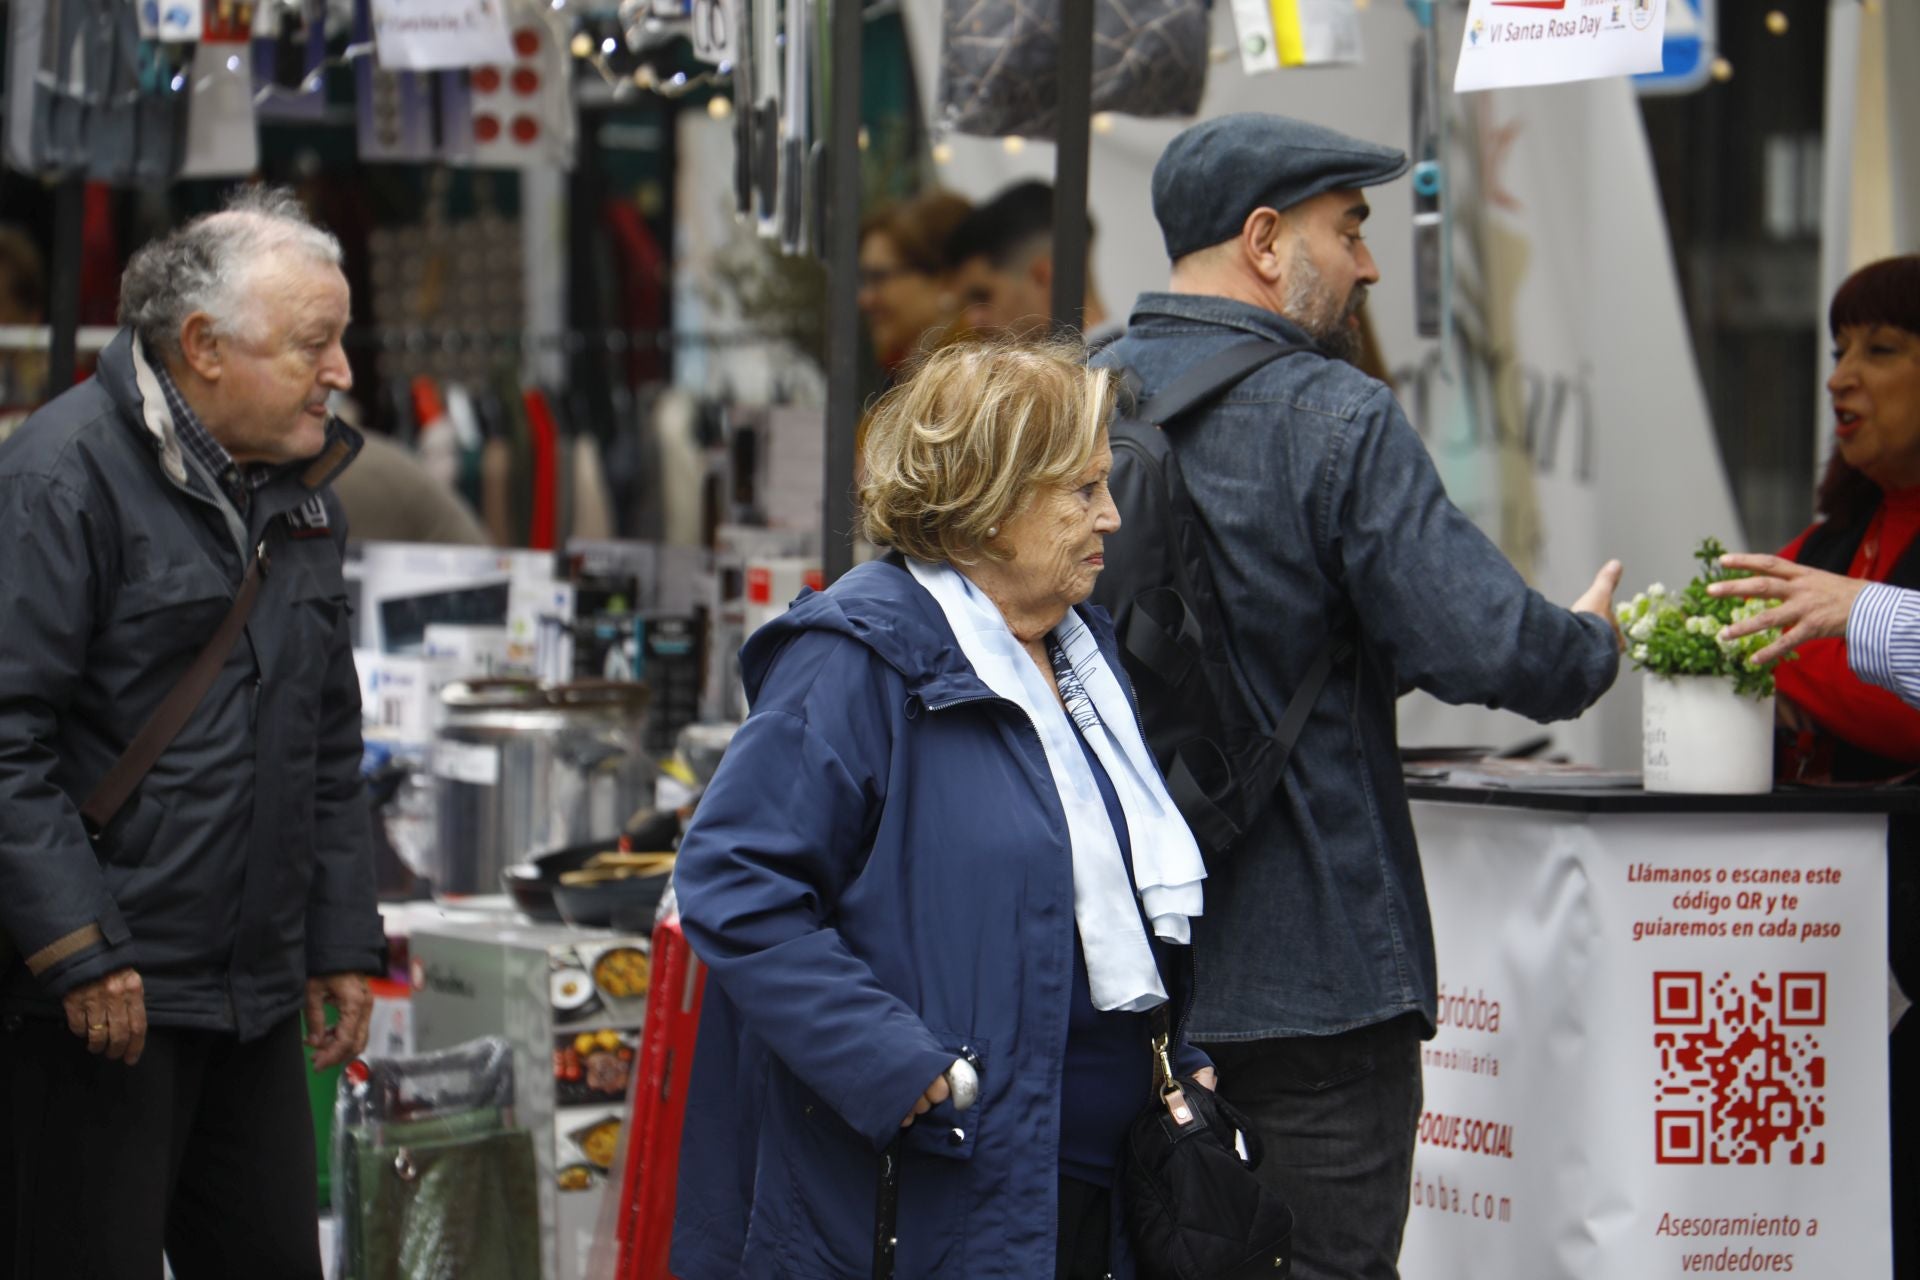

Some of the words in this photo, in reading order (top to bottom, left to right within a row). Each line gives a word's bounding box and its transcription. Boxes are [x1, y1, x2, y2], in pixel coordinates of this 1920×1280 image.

[1505, 23, 1543, 42] Santa
[1547, 18, 1576, 38] Rosa
[1579, 15, 1601, 38] Day
[1628, 863, 1711, 883] Llámanos
[1716, 869, 1727, 883] o
[1732, 869, 1801, 884] escanea
[1806, 867, 1842, 884] este
[1673, 891, 1731, 914] código
[1736, 892, 1762, 910] QR
[1766, 899, 1777, 915] y
[1781, 893, 1798, 910] te
[1632, 917, 1727, 941] guiaremos
[1732, 922, 1753, 936] en
[1758, 918, 1797, 937] cada
[1800, 923, 1841, 943] paso
[1436, 983, 1500, 1034] órdoba
[1423, 1048, 1499, 1077] nmobiliaria
[1418, 1111, 1461, 1149] OQUE
[1461, 1118, 1513, 1159] SOCIAL
[1414, 1171, 1511, 1222] doba.com
[1656, 1212, 1801, 1237] Asesoramiento
[1806, 1219, 1818, 1236] a
[1682, 1246, 1794, 1272] vendedores
